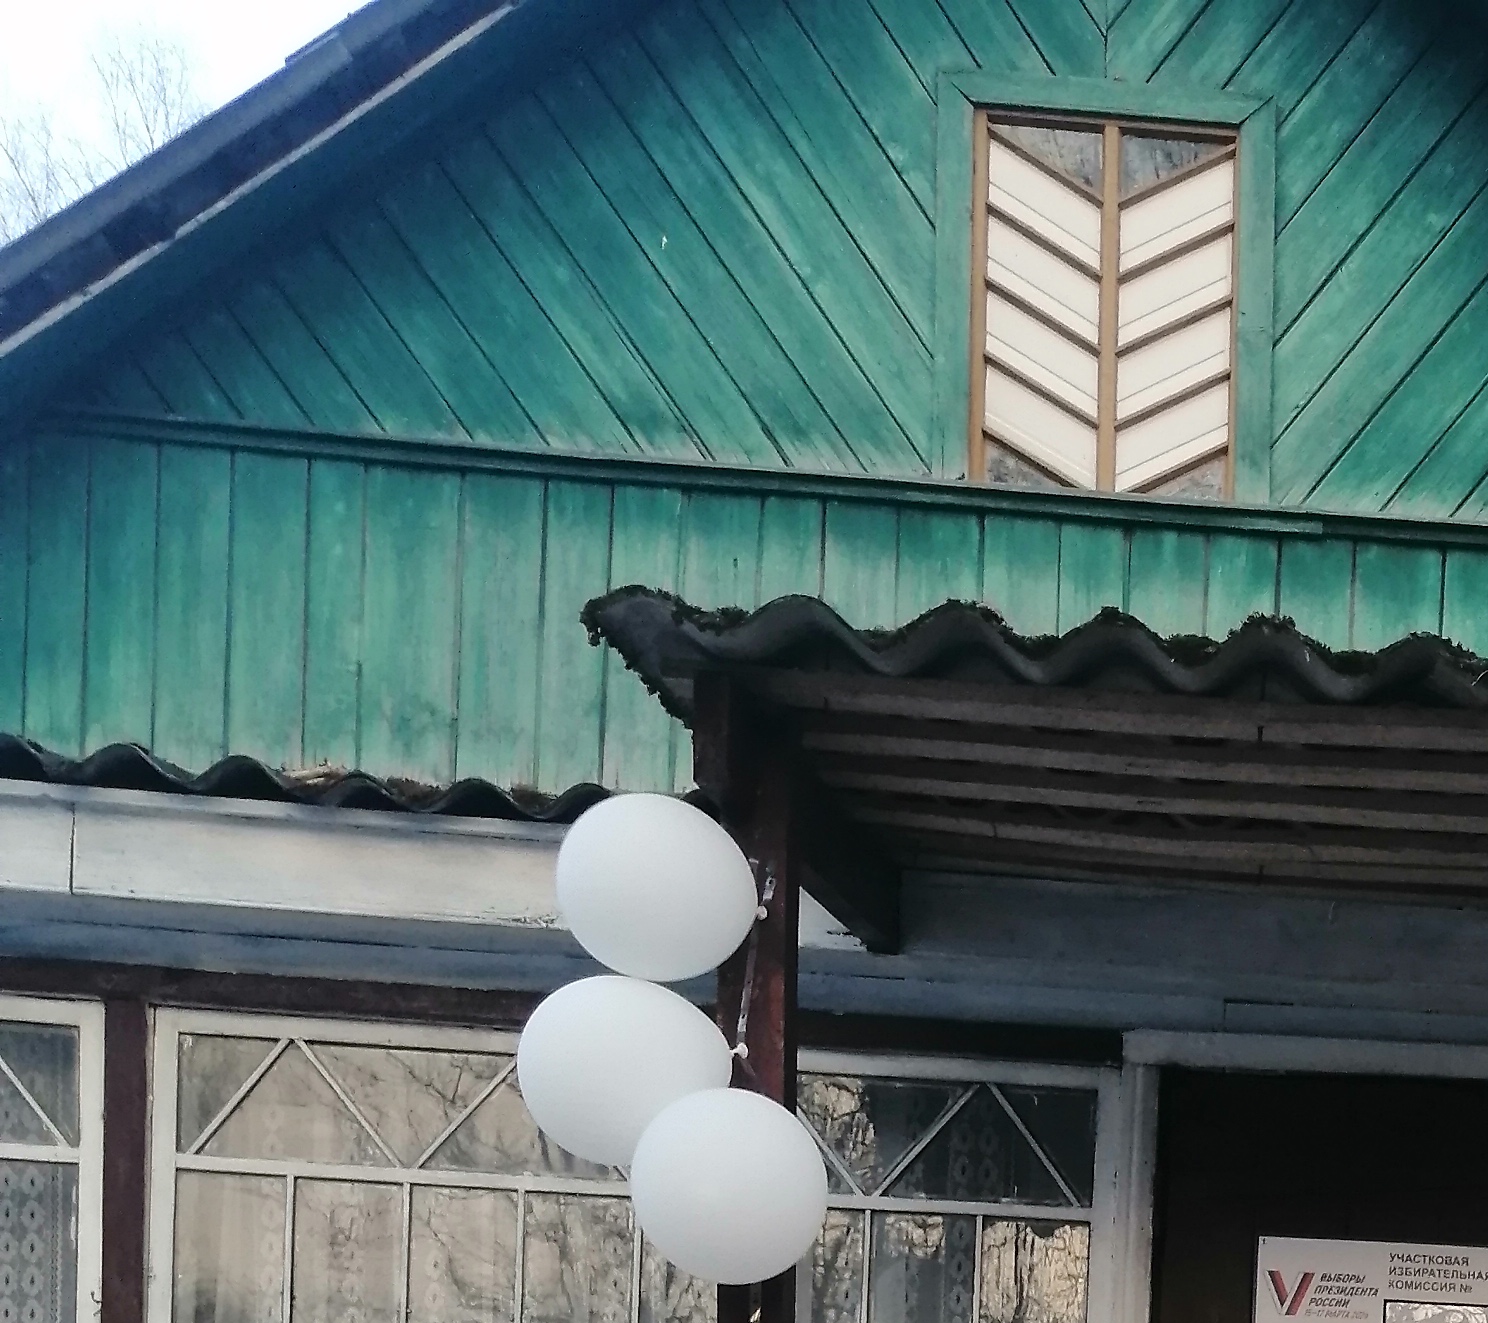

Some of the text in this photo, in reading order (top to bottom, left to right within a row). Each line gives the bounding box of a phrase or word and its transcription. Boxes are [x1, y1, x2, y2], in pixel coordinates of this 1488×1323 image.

[1389, 1252, 1470, 1267] УЧАСТКОВАЯ
[1320, 1272, 1366, 1284] ВЫБОРЫ
[1313, 1285, 1380, 1297] ПРЕЗИДЕНТА
[1388, 1279, 1456, 1293] КОМИССИЯ
[1308, 1297, 1351, 1308] РОССИИ
